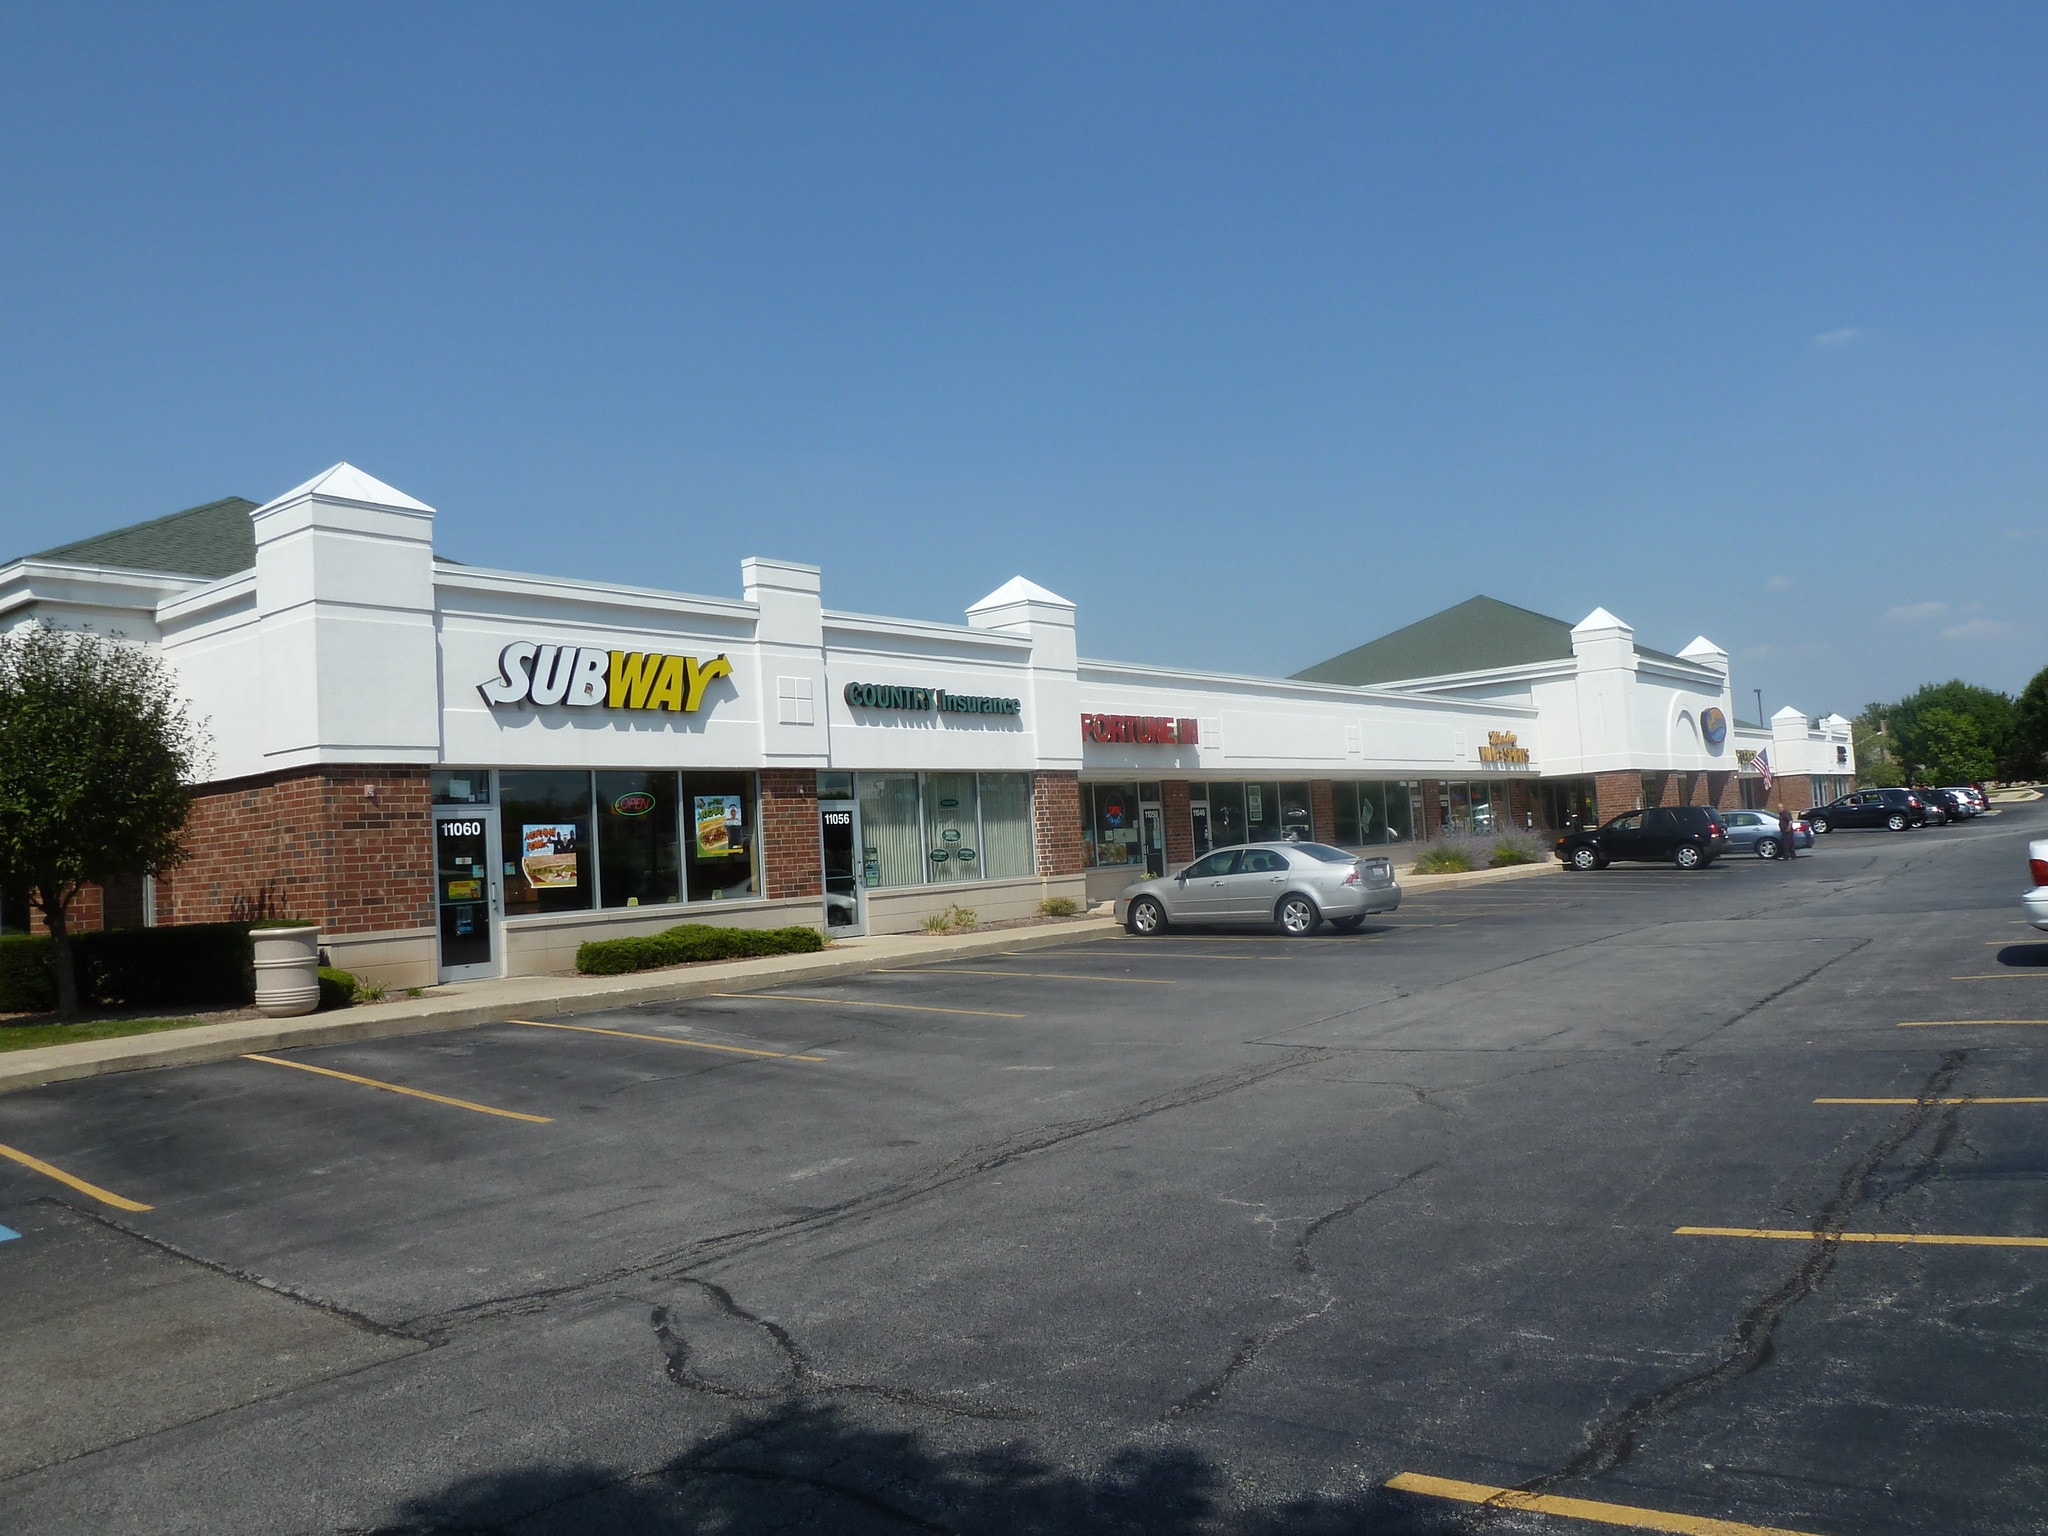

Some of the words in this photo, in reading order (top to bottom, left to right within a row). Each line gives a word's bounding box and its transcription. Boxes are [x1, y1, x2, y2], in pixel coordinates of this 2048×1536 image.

[476, 641, 733, 711] SUBWAY
[845, 682, 936, 710] COUNTRY
[938, 689, 1022, 714] Insurance
[1081, 713, 1176, 743] FORTUNE
[620, 797, 651, 810] OPEN
[441, 822, 481, 837] 11060
[824, 813, 850, 825] 11056
